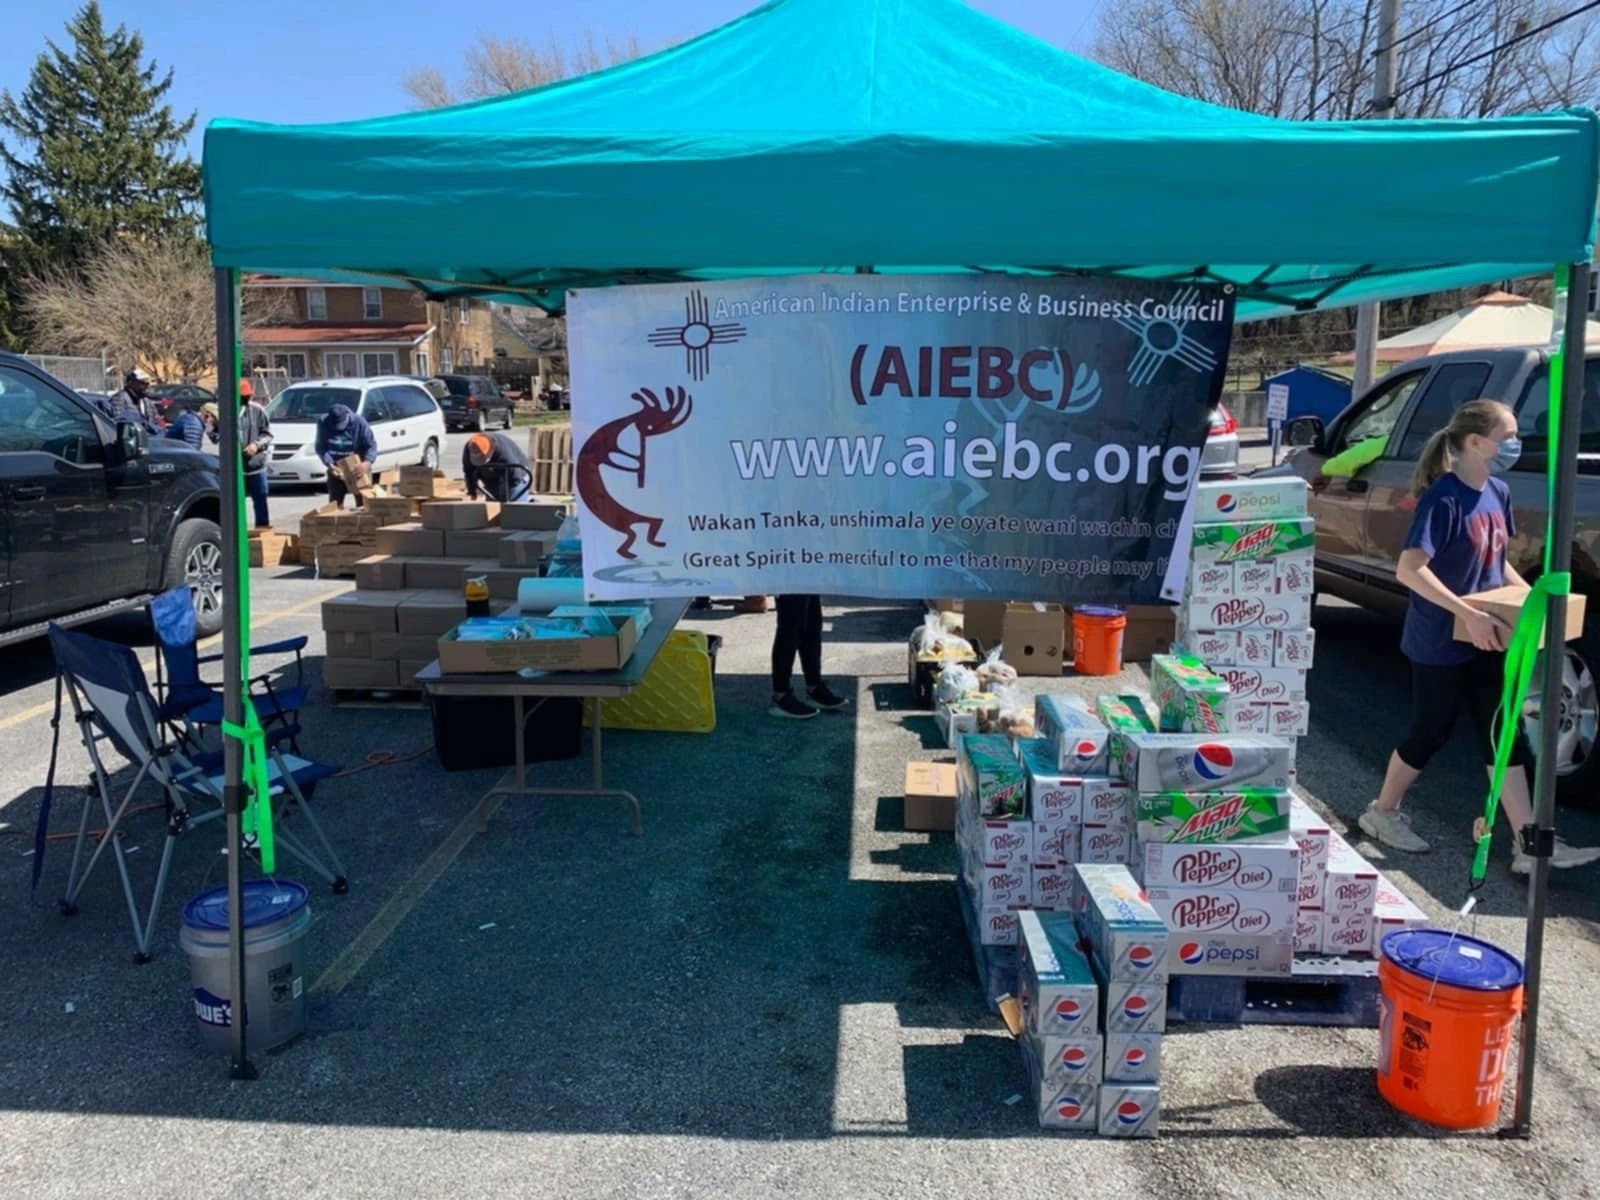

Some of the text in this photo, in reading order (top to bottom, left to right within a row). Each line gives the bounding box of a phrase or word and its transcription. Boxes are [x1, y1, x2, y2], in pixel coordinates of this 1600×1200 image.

[714, 292, 1225, 322] American Indian Enterprise & Business Council
[850, 343, 1075, 411] (AIEBC)
[730, 420, 1200, 500] www.aiebc.org
[1238, 492, 1280, 510] pepsi
[688, 513, 756, 532] Wakan
[760, 511, 825, 530] Tanka,
[830, 510, 925, 529] unshimala
[931, 515, 954, 533] ye
[960, 515, 1019, 537] oyate
[1025, 515, 1076, 536] wani
[1080, 517, 1152, 537] wachin
[683, 552, 740, 569] (Great
[746, 548, 796, 569] Spirit
[801, 547, 823, 564] be
[828, 549, 894, 567] merciful
[900, 553, 918, 568] to
[924, 553, 953, 568] me
[959, 551, 998, 569] that
[1004, 556, 1035, 576] my
[1040, 555, 1110, 578] people
[1112, 560, 1153, 580] may
[1214, 602, 1260, 626] Pepper
[1230, 599, 1248, 612] Dr
[1265, 613, 1284, 624] Diet
[1219, 673, 1258, 693] pper
[1228, 670, 1246, 683] Dr
[1261, 686, 1280, 697] Diet
[1175, 852, 1237, 883] Pepper
[1198, 850, 1221, 866] Dr
[1241, 871, 1265, 884] Diet
[1196, 895, 1220, 910] Dr
[1174, 898, 1236, 928] Pepper
[1239, 915, 1263, 928] Diet
[1206, 946, 1260, 962] pepsi
[1475, 1083, 1501, 1106] TH
